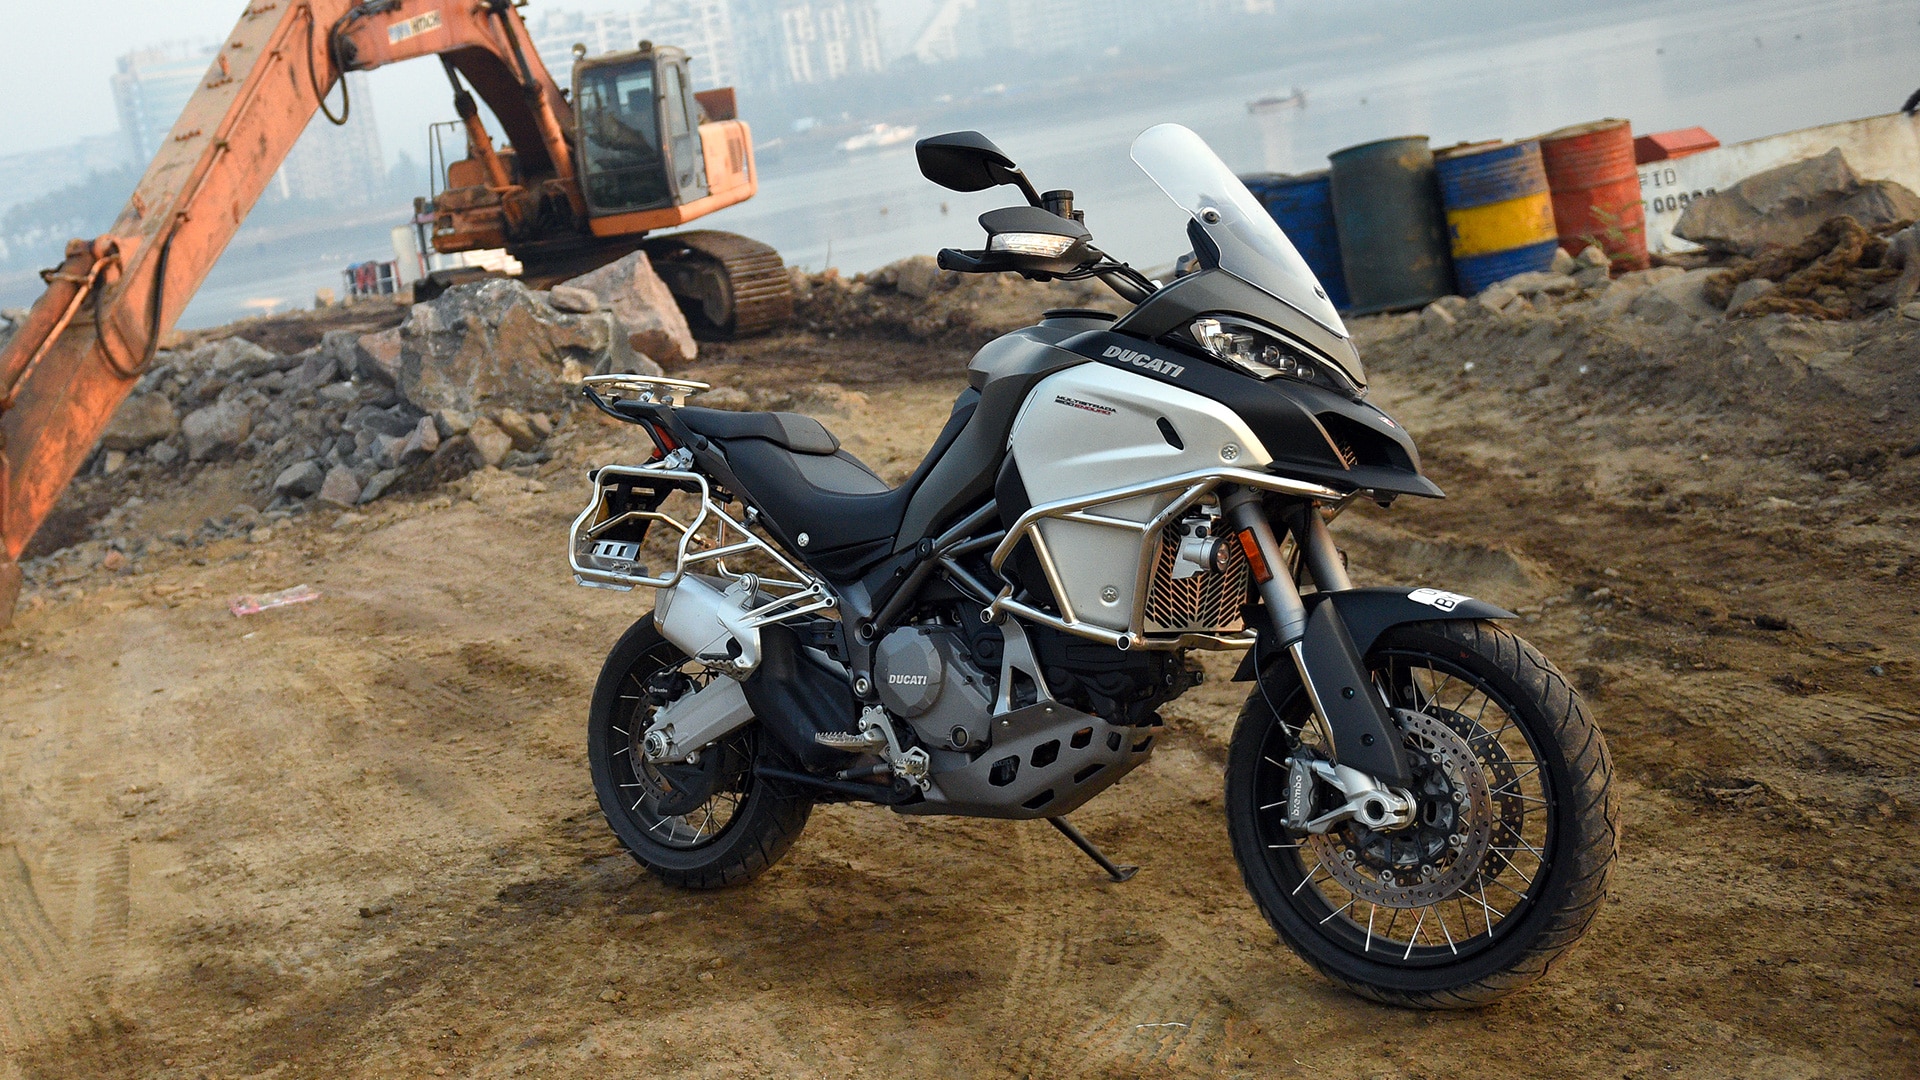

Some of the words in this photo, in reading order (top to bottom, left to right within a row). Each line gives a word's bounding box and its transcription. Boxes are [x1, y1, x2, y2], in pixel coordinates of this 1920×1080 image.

[1102, 345, 1185, 378] DUCATI
[1056, 395, 1117, 413] MULTISTRADA
[889, 674, 927, 685] DUCATI
[1291, 775, 1302, 816] brembo
